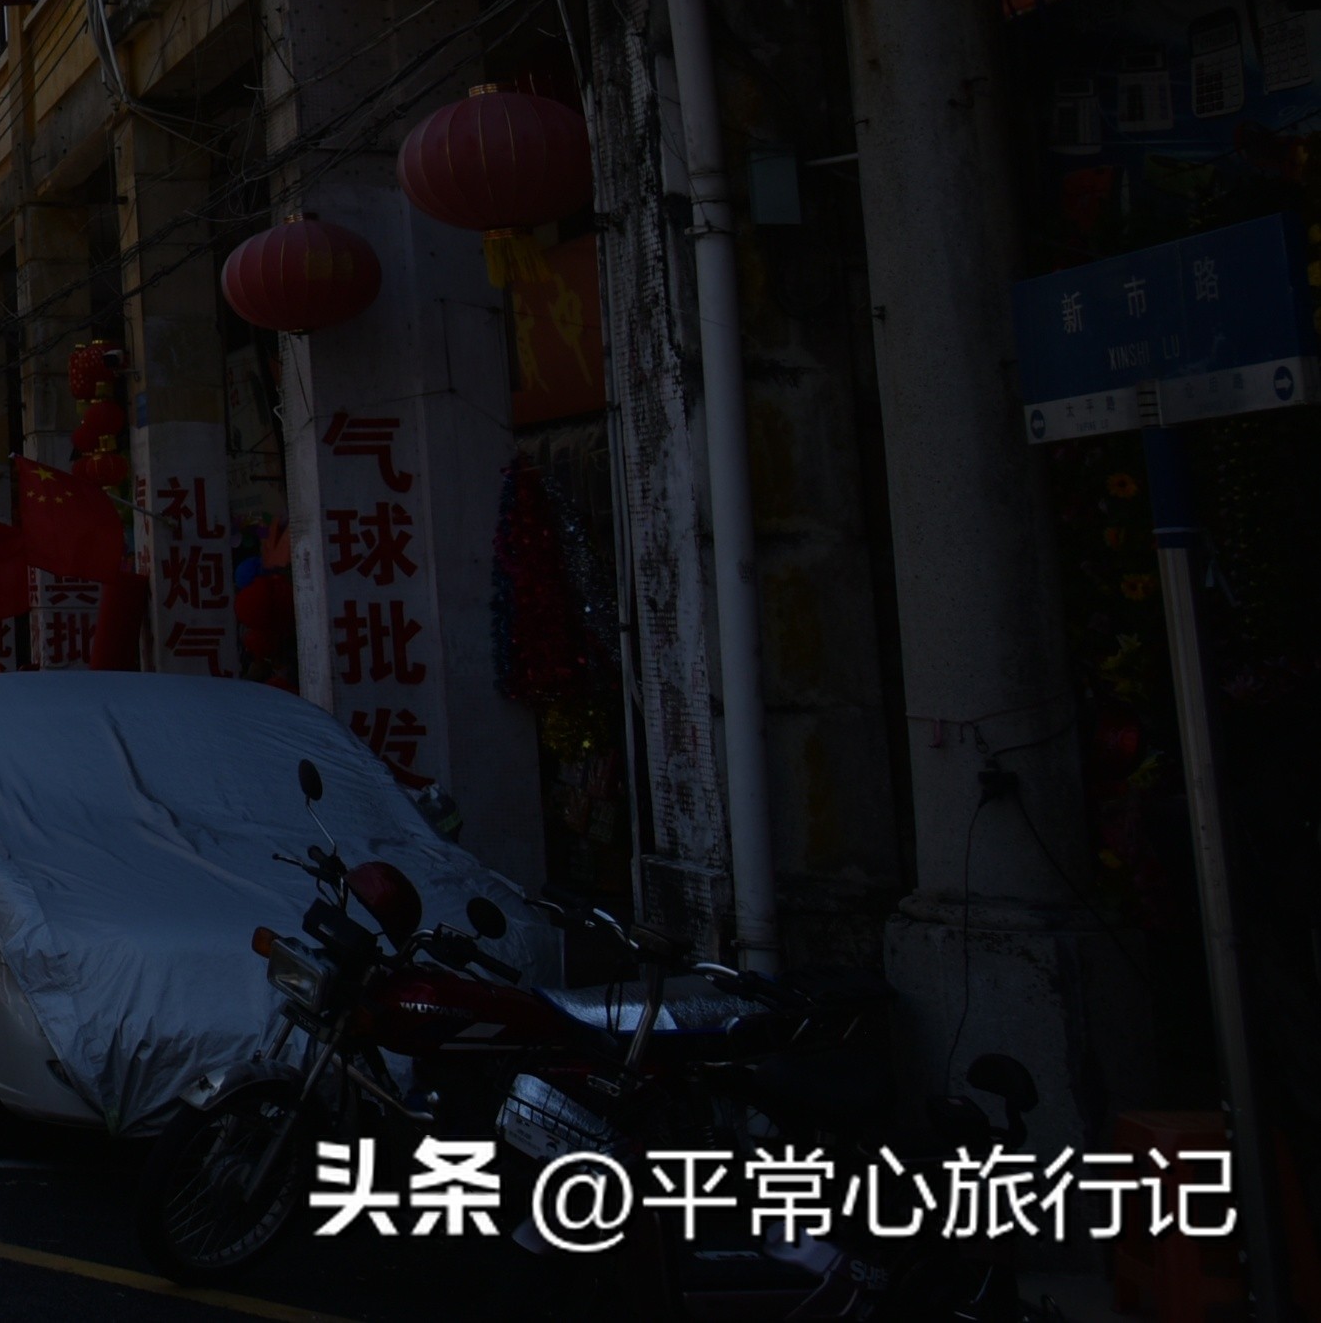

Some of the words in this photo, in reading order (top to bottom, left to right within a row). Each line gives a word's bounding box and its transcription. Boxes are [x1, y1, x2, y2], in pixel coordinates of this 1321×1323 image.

[1061, 255, 1220, 334] 新市路
[1108, 341, 1151, 372] XINSHI
[1162, 334, 1181, 359] LU
[321, 412, 435, 790] 气球批发
